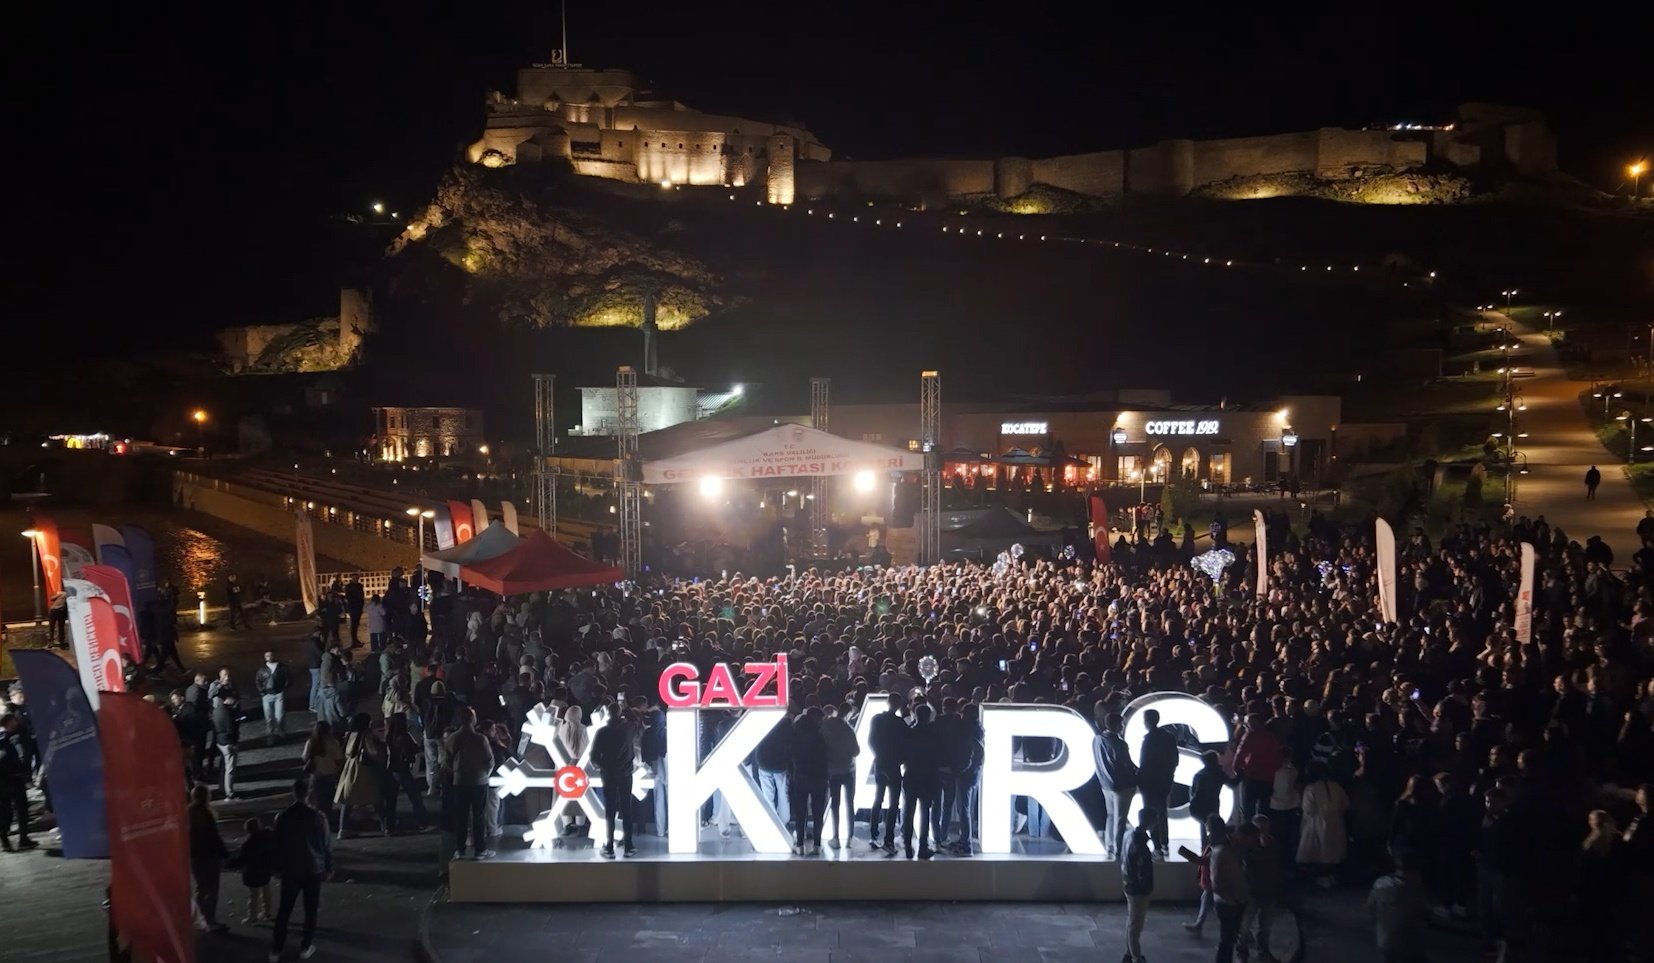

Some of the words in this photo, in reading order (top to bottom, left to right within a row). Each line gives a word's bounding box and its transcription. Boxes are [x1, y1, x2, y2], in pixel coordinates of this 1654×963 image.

[1001, 423, 1047, 434] KOCATEPE
[1145, 421, 1195, 435] COFFEE
[751, 463, 825, 477] HAFTASI
[659, 653, 789, 708] GAZİ
